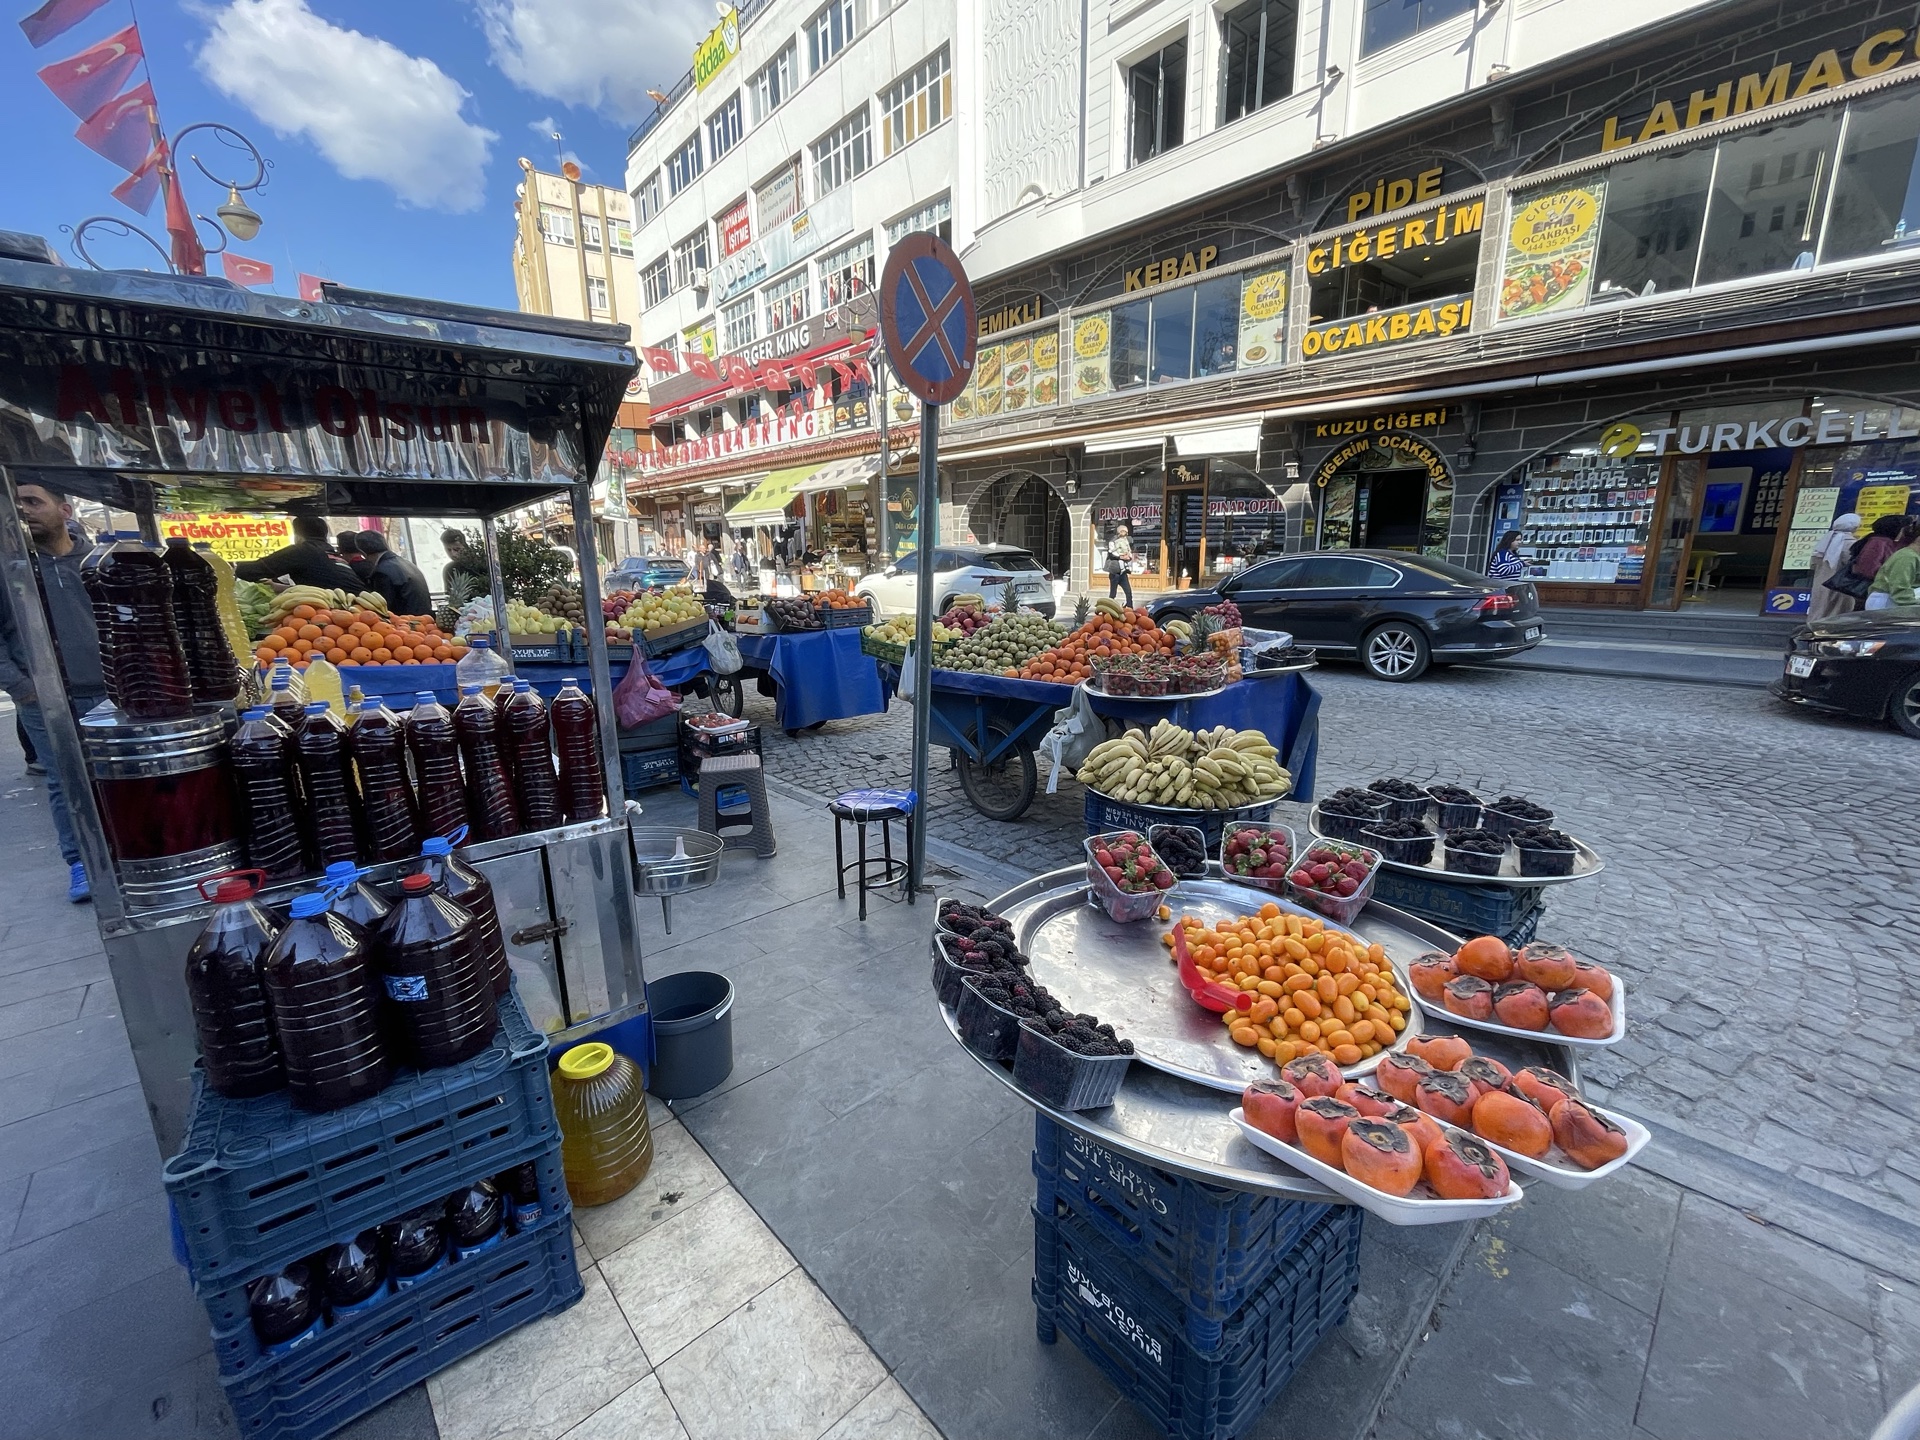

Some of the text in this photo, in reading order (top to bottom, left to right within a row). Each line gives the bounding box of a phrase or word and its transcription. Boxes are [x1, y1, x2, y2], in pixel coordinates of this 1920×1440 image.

[696, 40, 725, 86] iddaa
[1600, 28, 1920, 152] LAHMAC
[774, 172, 795, 193] SIEMENS
[1347, 166, 1443, 223] PİDE
[1521, 225, 1581, 246] OCAKBAŞI
[1527, 243, 1543, 252] 444
[1546, 239, 1558, 248] 35
[1124, 245, 1218, 293] KEBAP
[978, 294, 1041, 337] EMİKLİ
[1302, 299, 1473, 356] OCAKBAŞI
[776, 324, 811, 359] KING
[58, 362, 490, 445] Afiyet Olsun
[1316, 407, 1447, 438] KUZU CİĞERİ
[1650, 410, 1919, 456] TURKCELL
[1317, 435, 1448, 489] CİĞERİM OCAKBAŞI
[1099, 502, 1161, 521] PINAR OPTİK
[1209, 500, 1246, 516] PINAR
[211, 538, 281, 550] CAT USTA
[226, 550, 247, 560] 358
[250, 549, 260, 559] 72
[1067, 1259, 1162, 1354] B-30 D.BAKIR
[1067, 1269, 1162, 1367] MUSTAA
